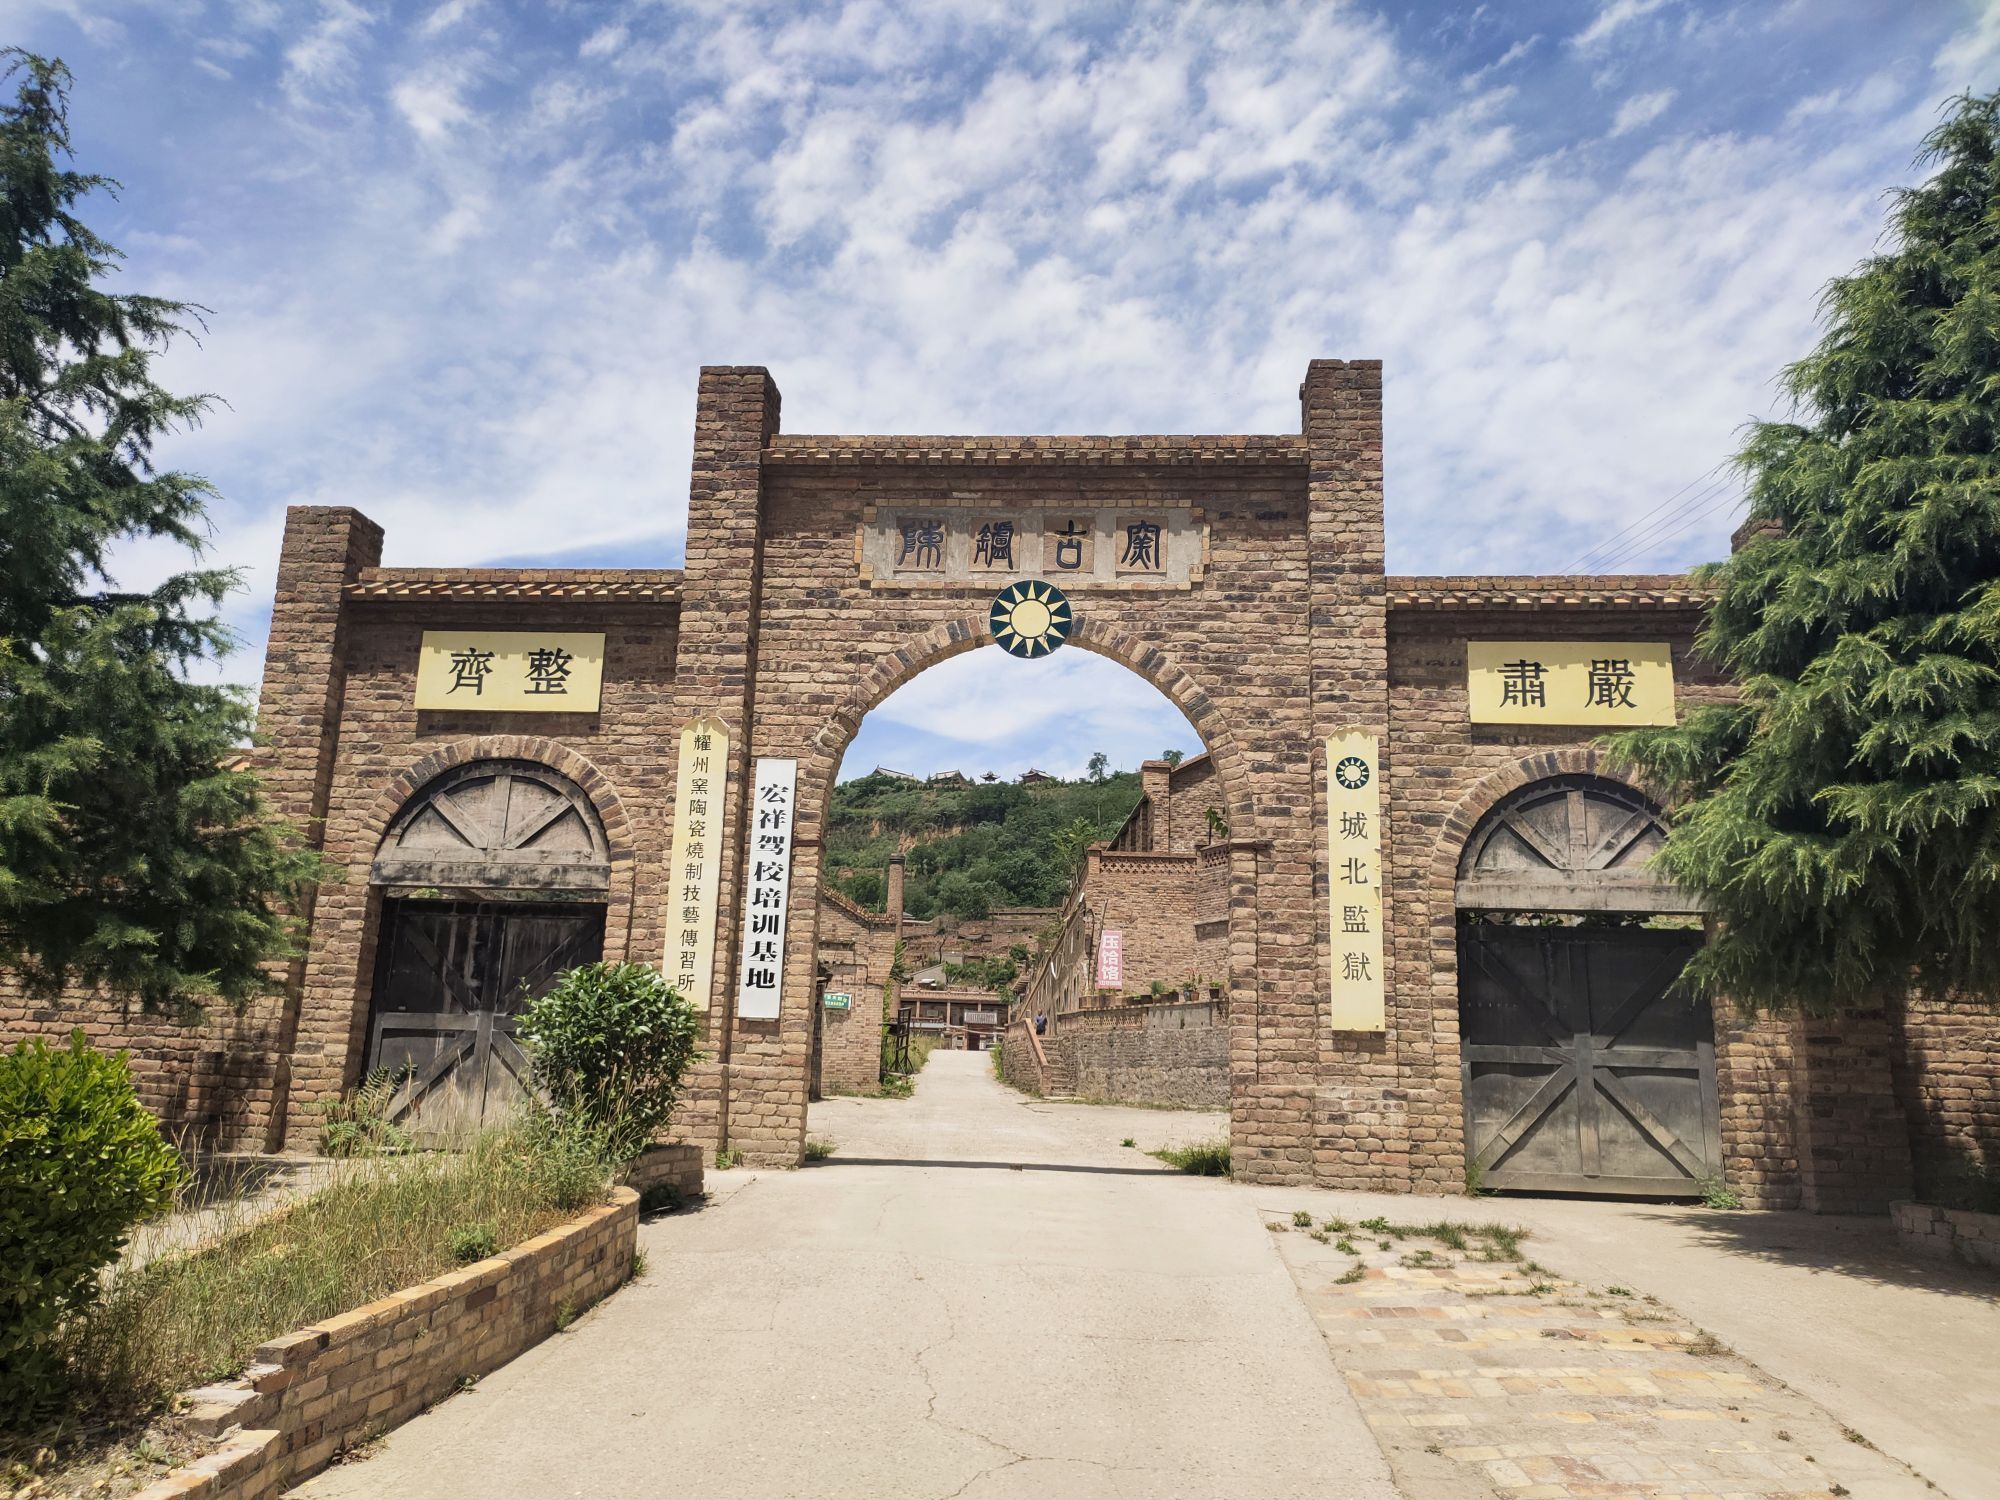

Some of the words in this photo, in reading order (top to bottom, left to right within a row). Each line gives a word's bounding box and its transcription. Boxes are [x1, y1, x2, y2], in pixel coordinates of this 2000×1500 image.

[745, 783, 789, 990] 宏祥驾校培训基地
[1339, 810, 1373, 983] 城北監獄
